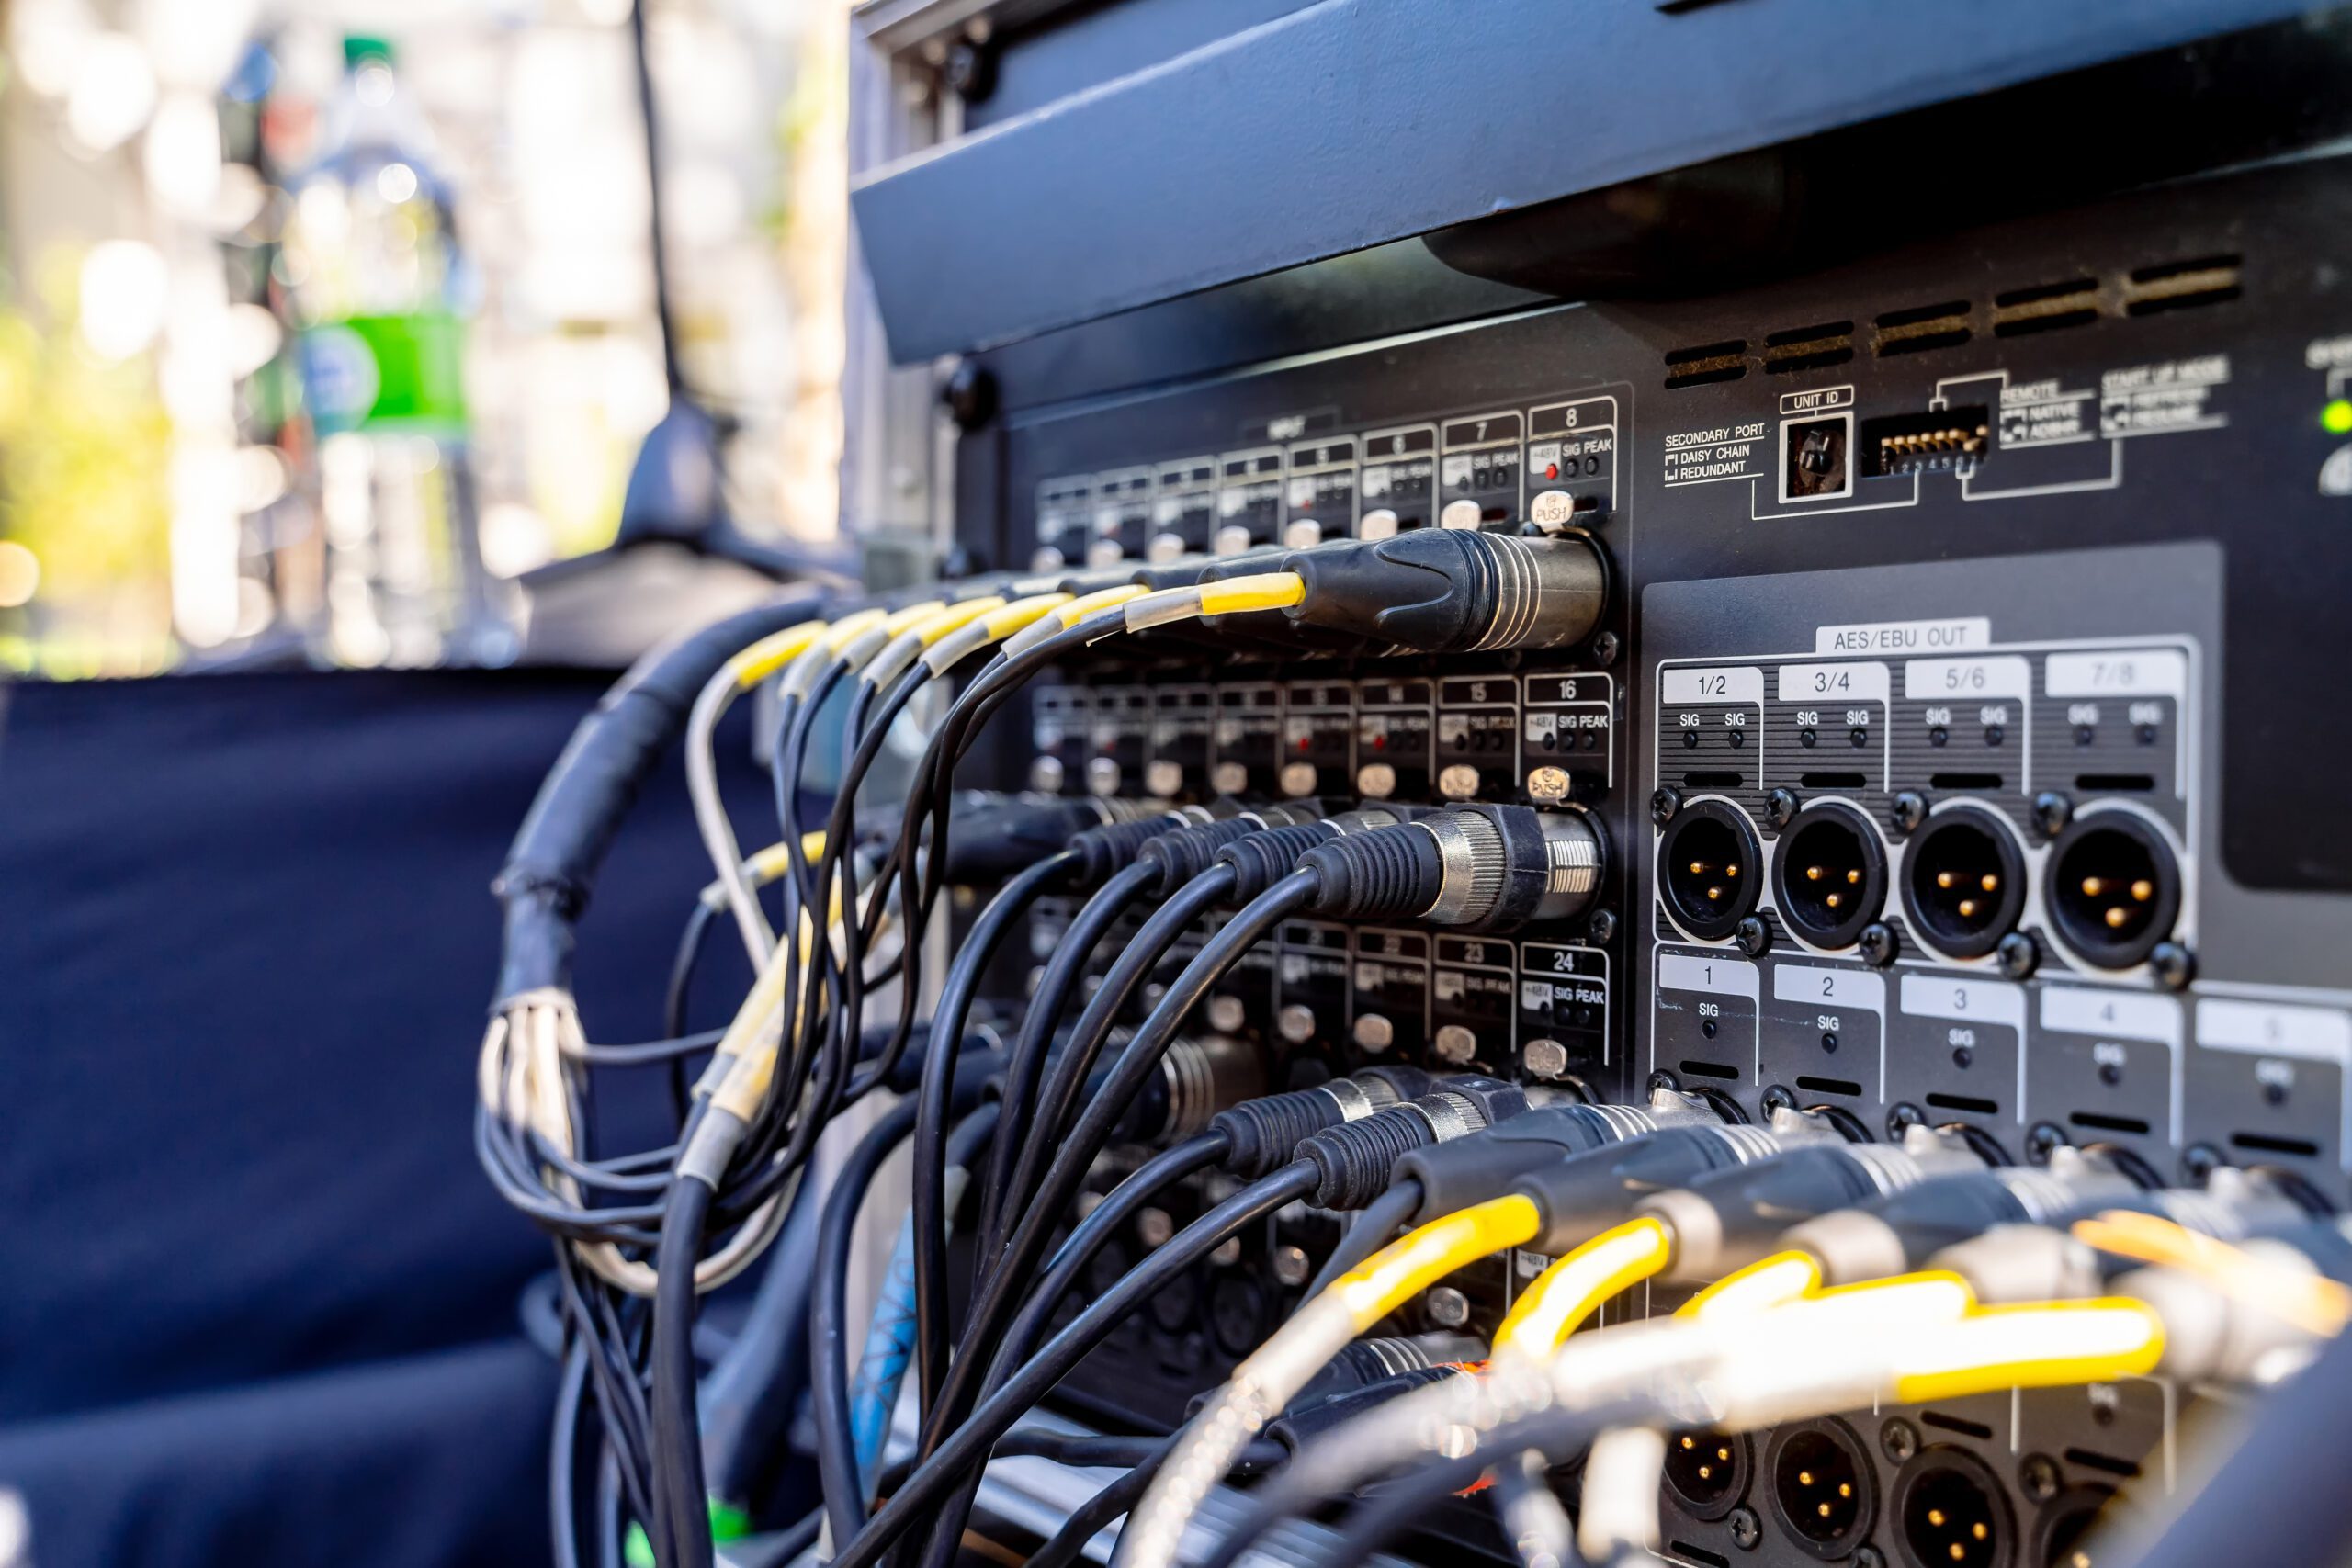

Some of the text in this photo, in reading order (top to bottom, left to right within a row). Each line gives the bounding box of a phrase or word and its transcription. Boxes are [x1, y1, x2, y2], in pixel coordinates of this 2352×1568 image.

[1794, 391, 1838, 409] UNIT ID
[1566, 408, 1577, 427] 8
[1476, 421, 1487, 441] 7
[1666, 423, 1764, 447] SECONDARY PORT
[1563, 443, 1581, 457] SIG
[1584, 438, 1611, 454] PEAK
[1681, 445, 1749, 464] DAISY CHAIN
[1681, 460, 1746, 479] REDUNDANT
[1902, 463, 1908, 473] 2
[1536, 507, 1566, 523] PUSH
[1834, 626, 1967, 650] AES/EBU OUT
[1699, 675, 1726, 694] 1/2
[1815, 671, 1850, 692] 3/4
[1945, 667, 1985, 690] 5/6
[1559, 680, 1577, 699] 16
[1558, 716, 1577, 728] SIG
[1579, 715, 1608, 728] PEAK
[1679, 713, 1700, 727] SIG
[1724, 713, 1745, 727] SIG
[1796, 711, 1818, 726] SIG
[1846, 709, 1869, 725] SIG
[1926, 707, 1951, 725] SIG
[1980, 705, 2007, 725] SIG
[1464, 943, 1485, 964] 23
[1554, 951, 1575, 972] 24
[1704, 966, 1712, 985] 1
[1554, 987, 1573, 1001] SIG
[1575, 988, 1605, 1005] PEAK
[1822, 976, 1834, 997] 2
[1953, 988, 1967, 1010] 3
[1699, 1002, 1718, 1017] SIG
[1817, 1015, 1839, 1031] SIG
[1949, 1028, 1976, 1047] SIG
